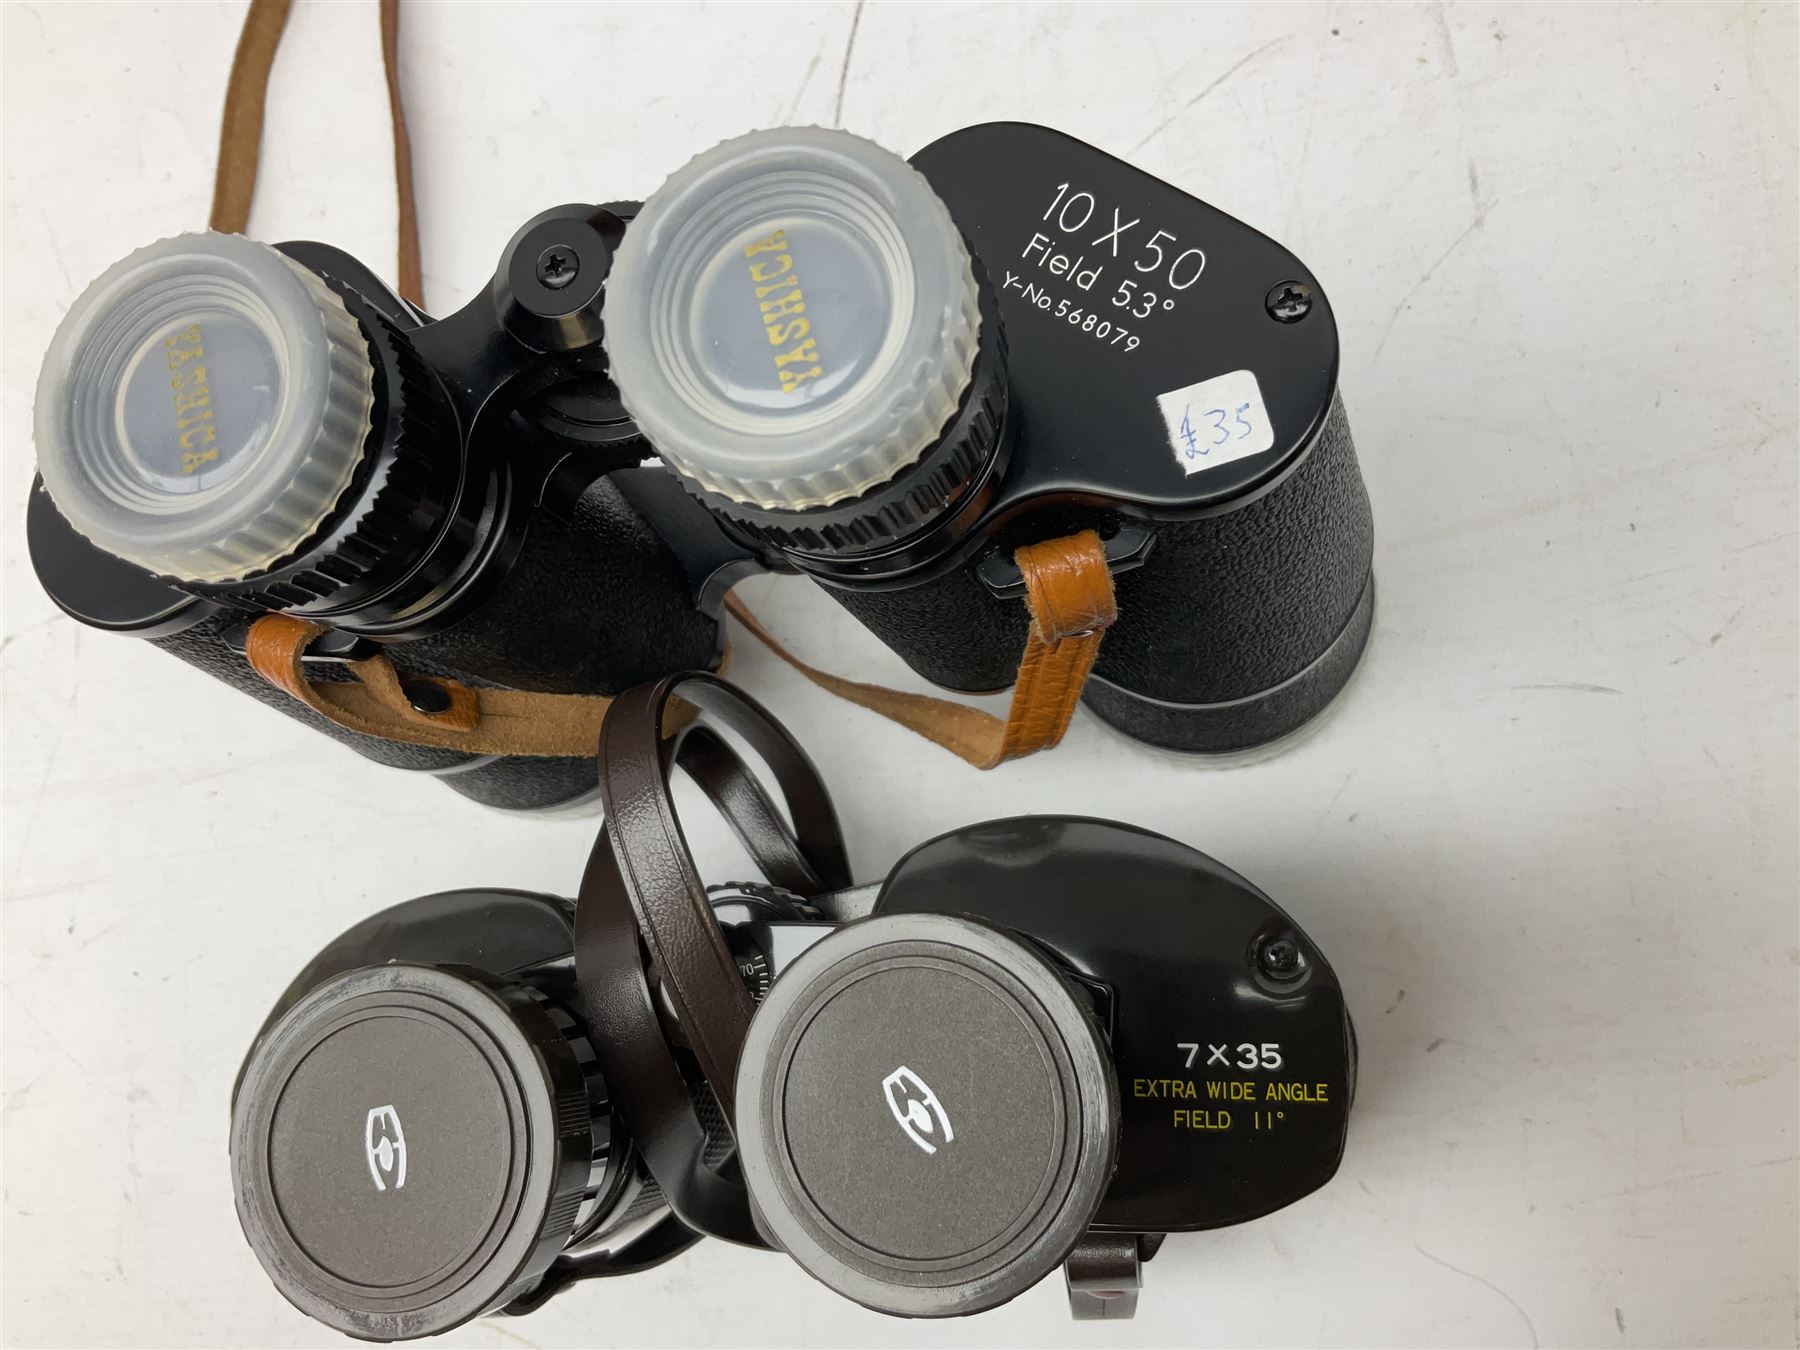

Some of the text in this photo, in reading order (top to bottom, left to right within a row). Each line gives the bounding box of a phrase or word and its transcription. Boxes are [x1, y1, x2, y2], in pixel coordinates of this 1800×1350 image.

[1022, 232, 1103, 291] Field
[744, 229, 822, 394] YASHICA
[165, 324, 219, 474] YASHICA
[1180, 403, 1254, 459] £35
[739, 963, 754, 977] 70
[1133, 1079, 1329, 1102] EXTRA WIDE ANGLE
[1173, 1110, 1231, 1129] FIELD
